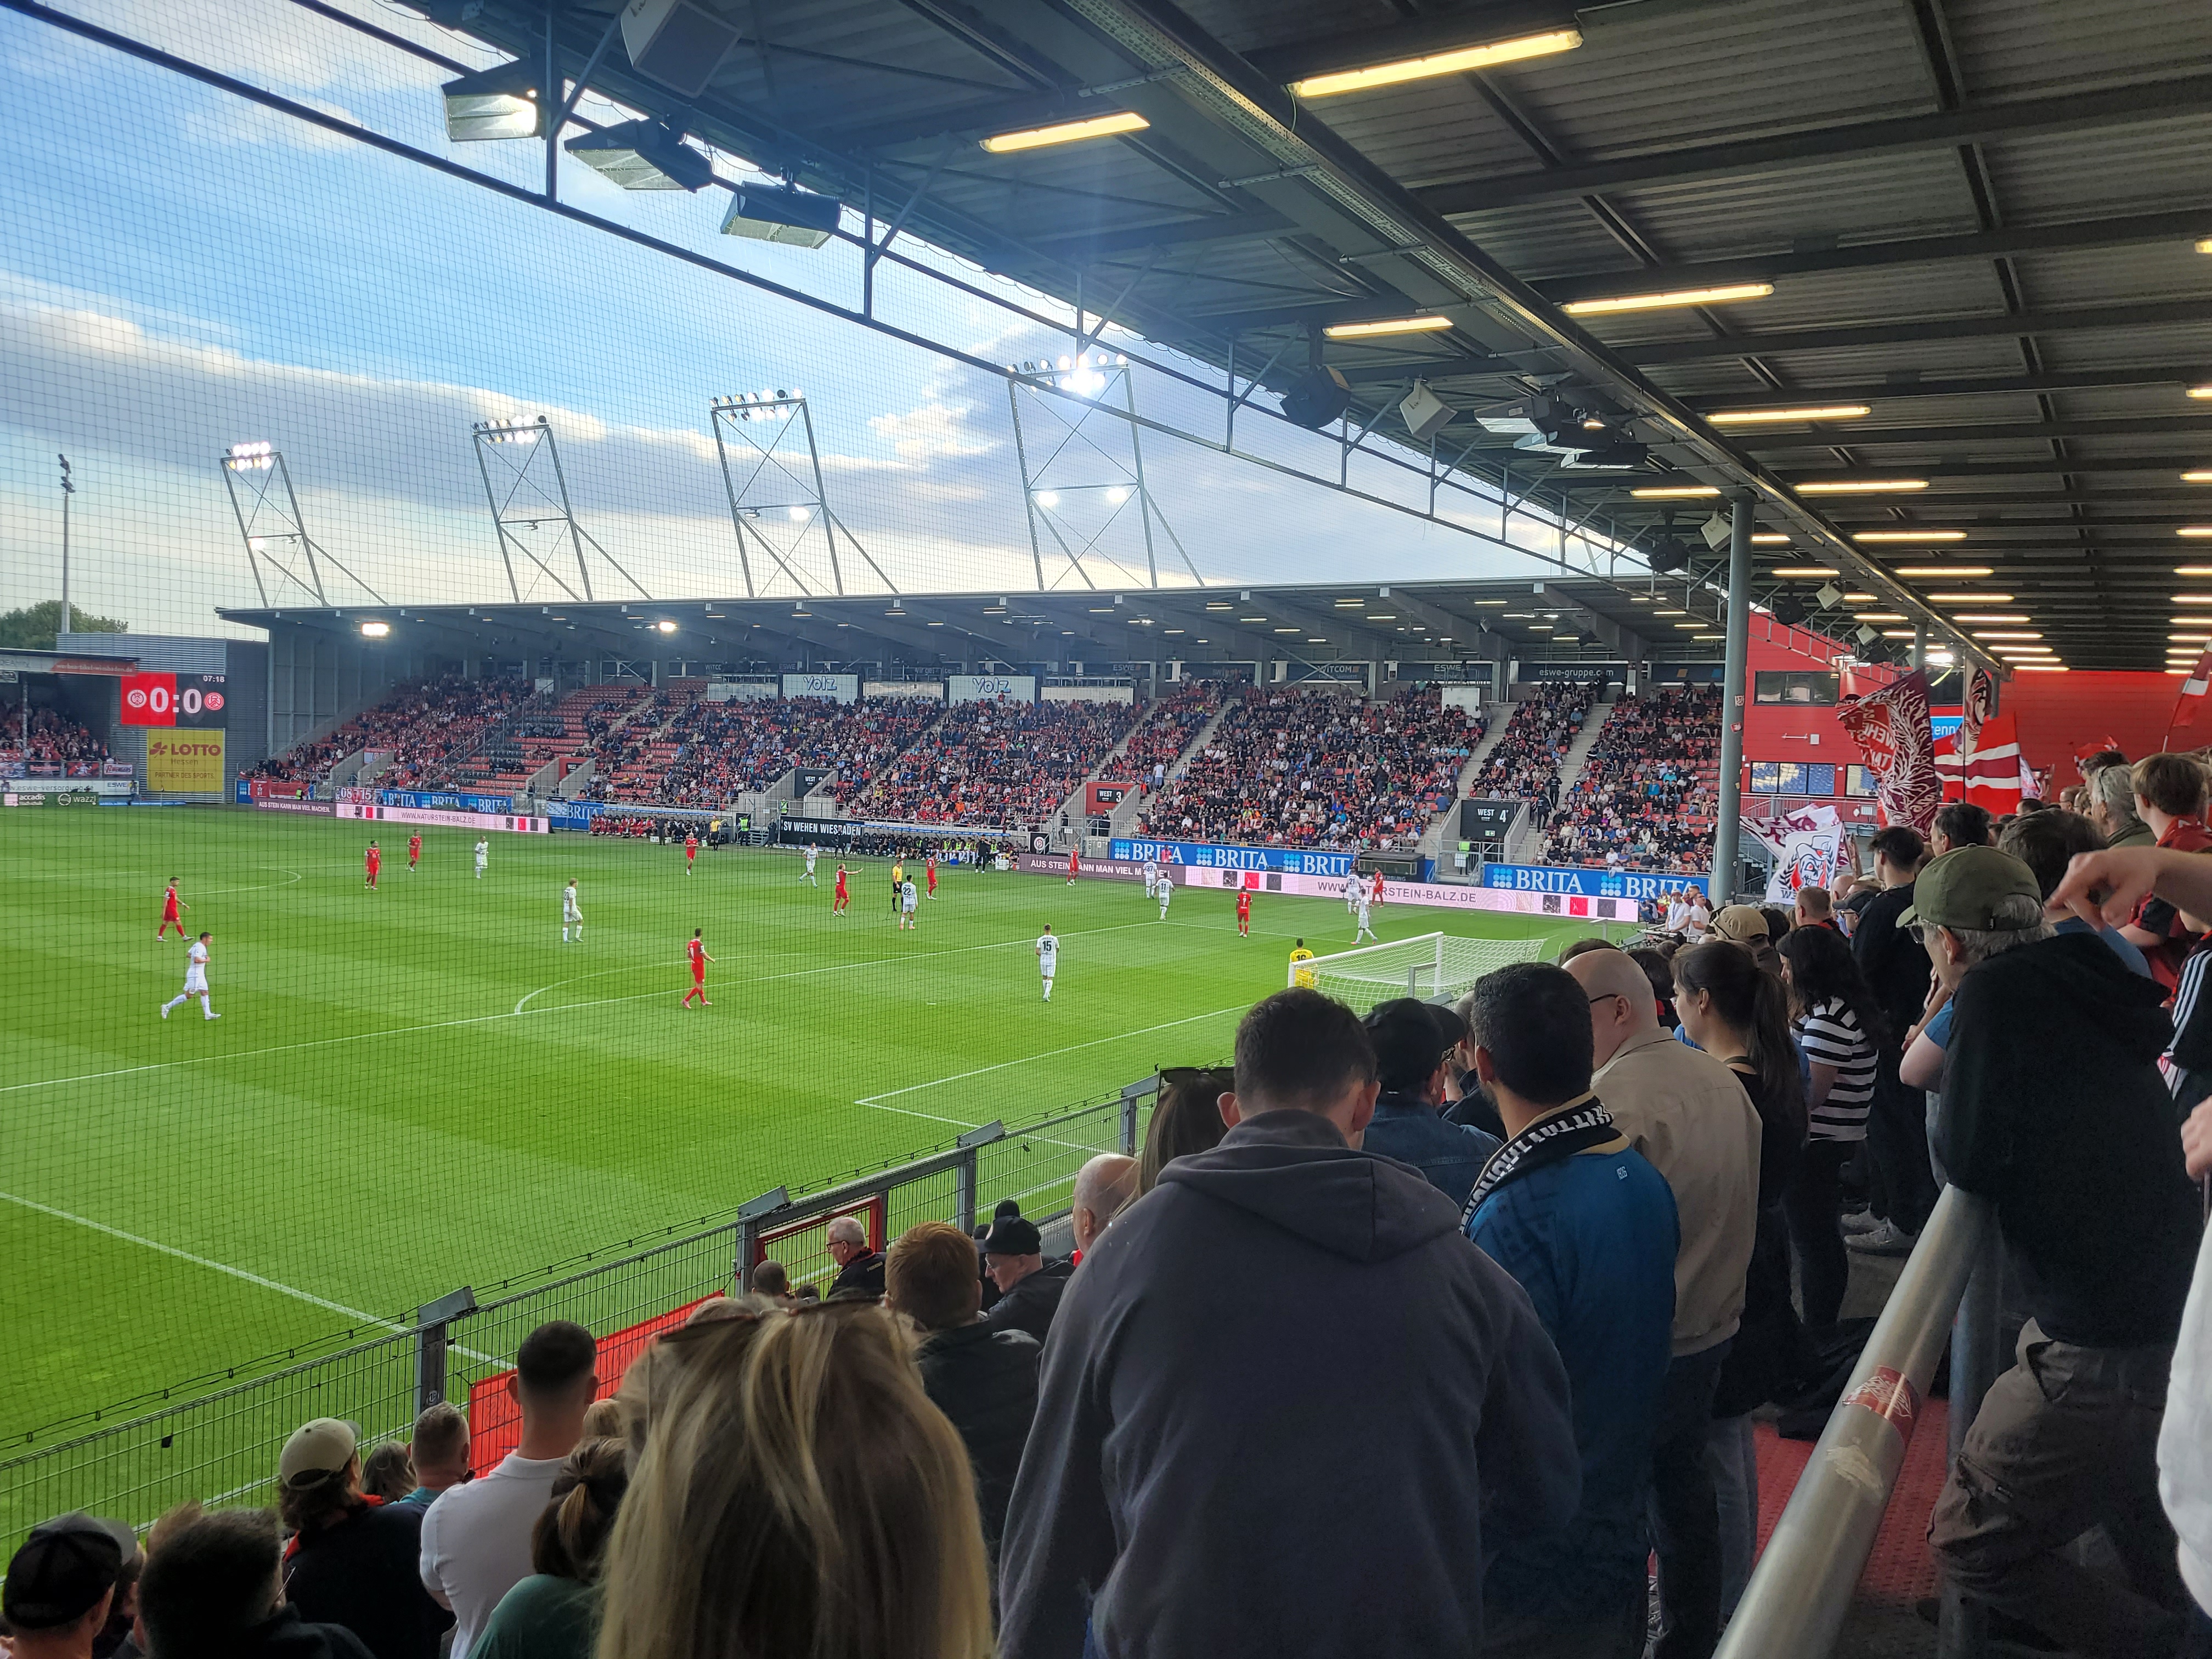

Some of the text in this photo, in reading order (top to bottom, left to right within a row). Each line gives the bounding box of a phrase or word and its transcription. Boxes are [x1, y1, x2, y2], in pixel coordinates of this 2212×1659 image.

[1539, 669, 1614, 678] eswe-gruppe.cm
[171, 743, 221, 757] LOTTO
[1116, 791, 1122, 802] 3
[401, 812, 476, 824] WWW.NATURSTEIN-BALZ.DE
[1477, 808, 1496, 816] WEST
[1499, 809, 1507, 822] 4
[783, 821, 792, 831] SV
[793, 822, 818, 833] WEHEN
[1215, 848, 1268, 870] BRITA
[1030, 859, 1047, 868] AUS
[1048, 860, 1070, 870] STEIN
[1078, 863, 1094, 872] ANN
[1096, 864, 1114, 874] MAN
[1115, 866, 1133, 876] VIEL
[1161, 882, 1167, 891] 11
[1515, 868, 1584, 894] BRITA
[903, 887, 911, 896] 22
[1042, 940, 1052, 951] 15
